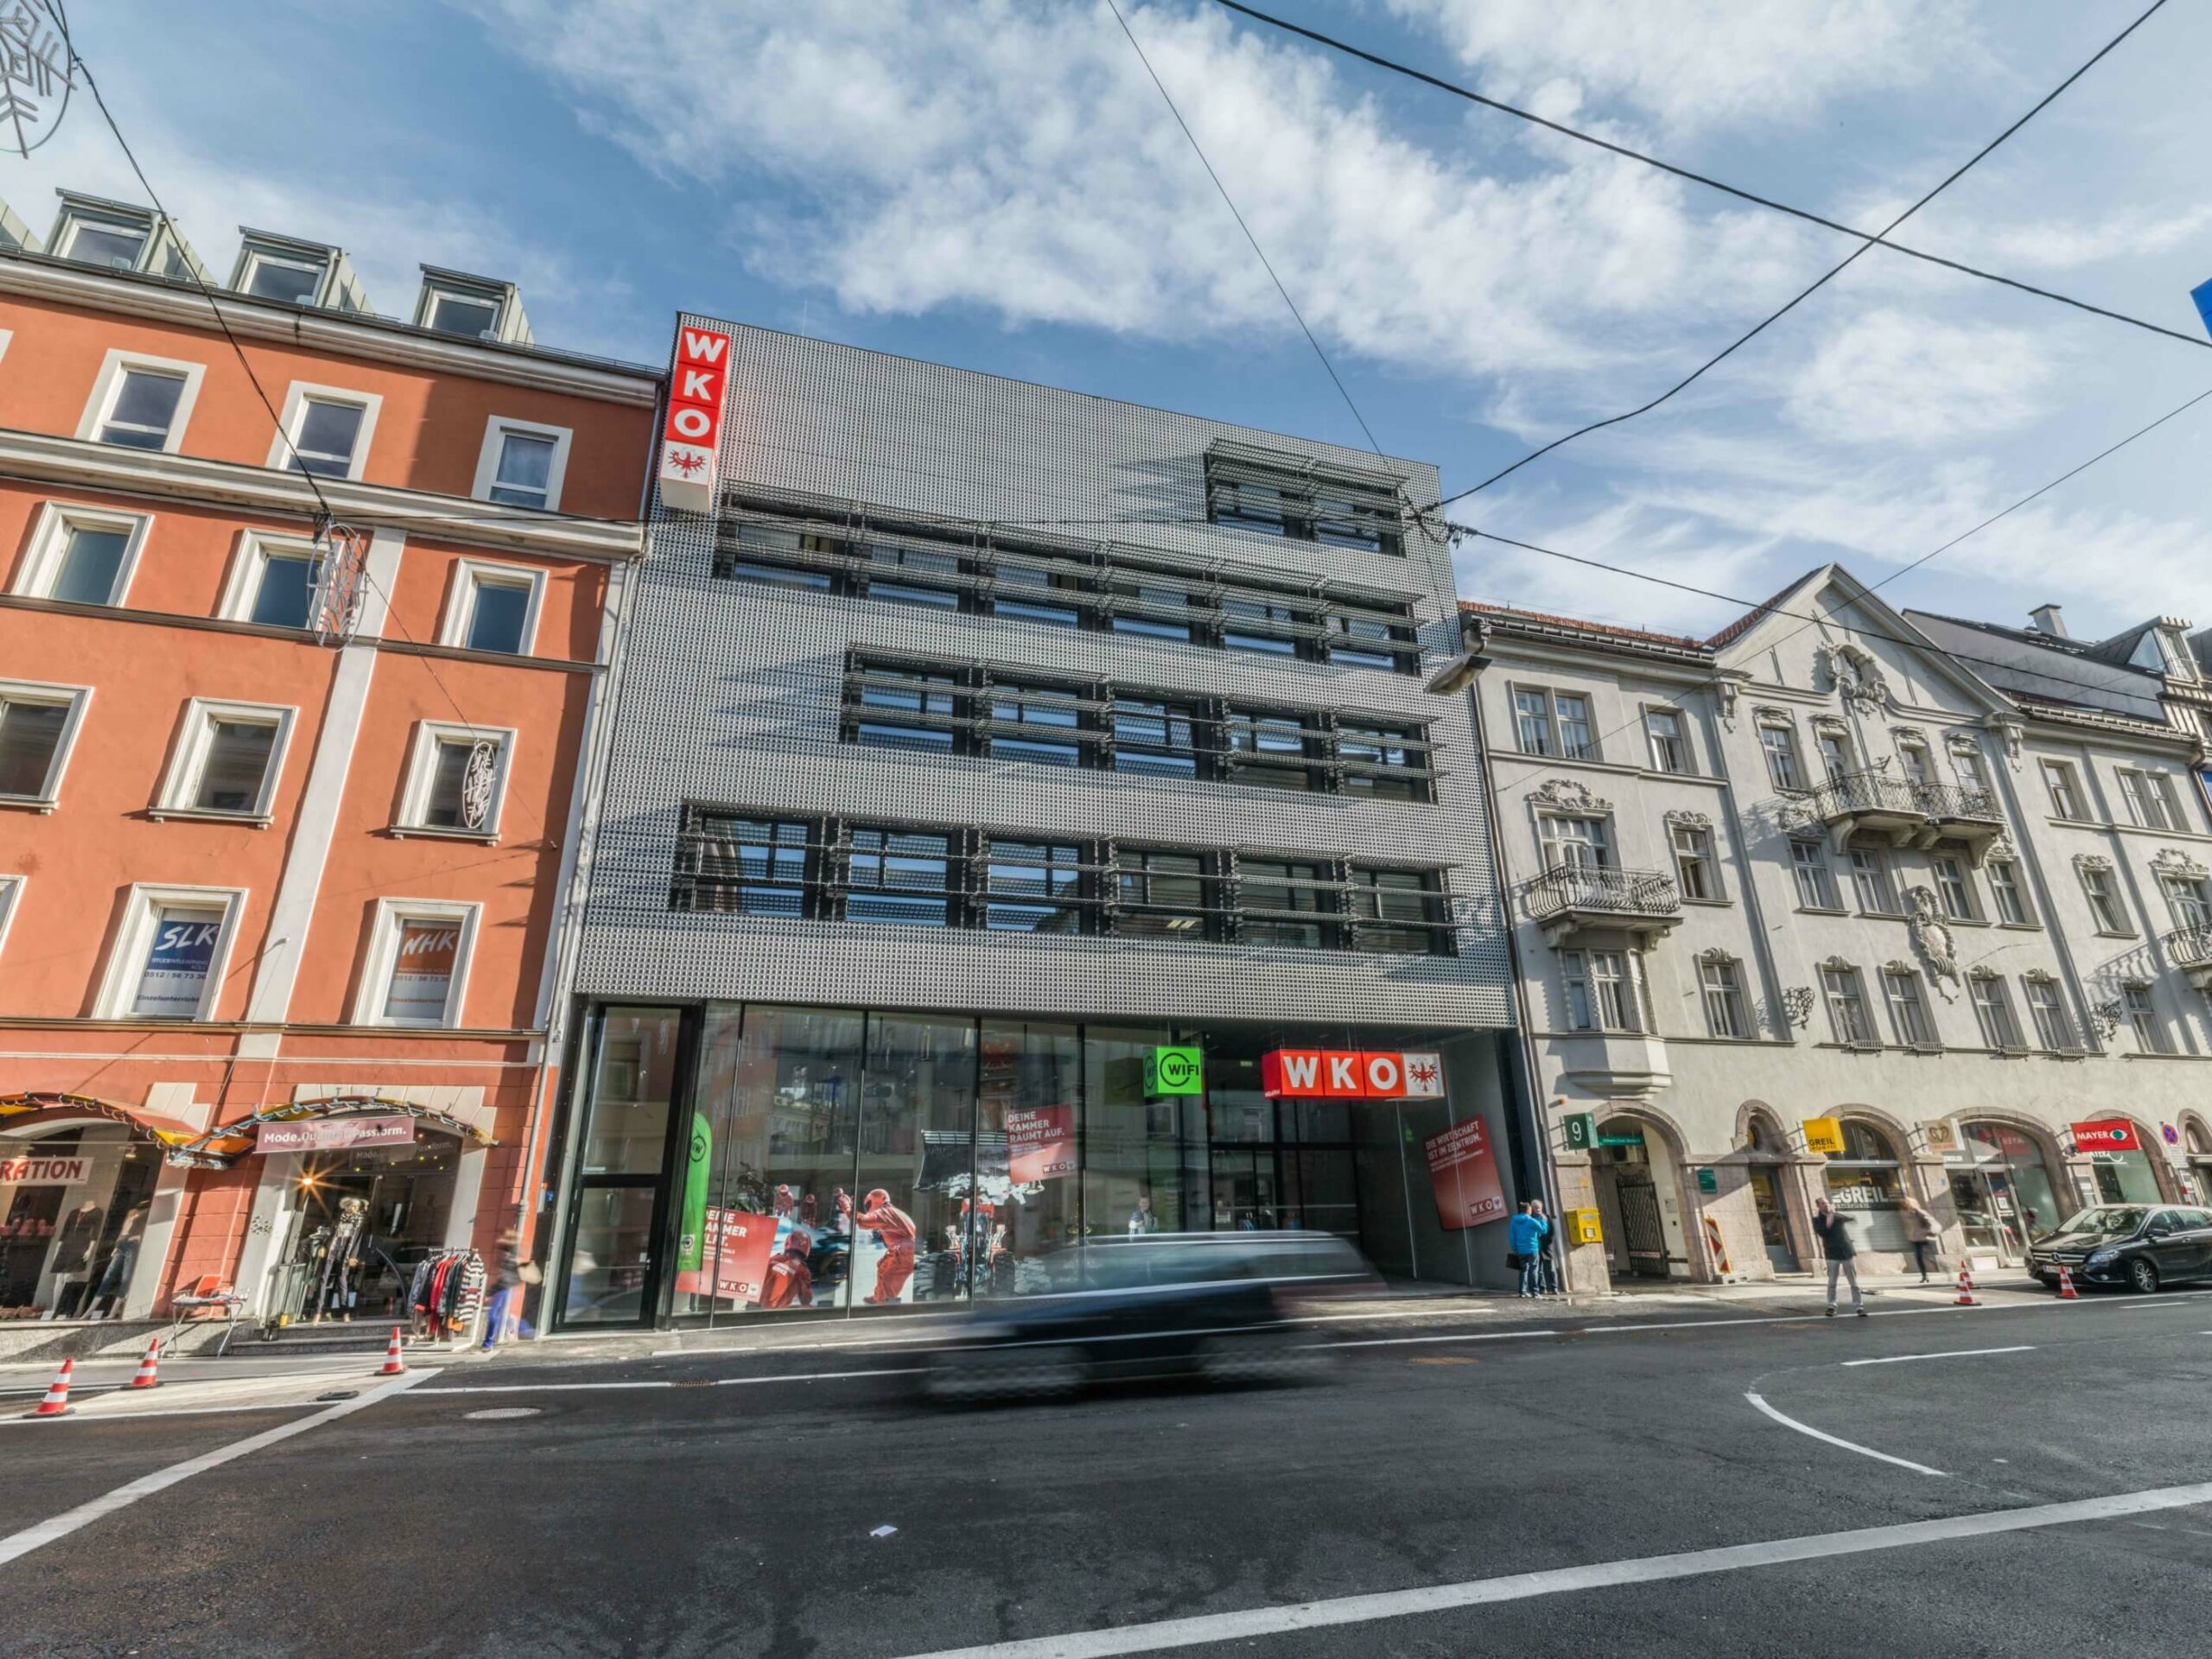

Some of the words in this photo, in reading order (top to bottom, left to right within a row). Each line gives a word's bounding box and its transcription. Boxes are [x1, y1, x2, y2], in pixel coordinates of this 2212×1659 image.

[674, 332, 726, 437] WKO
[155, 925, 219, 950] SLK
[402, 931, 457, 956] NHK
[1167, 1064, 1199, 1076] WIFI
[1283, 1056, 1398, 1090] WKO
[1007, 1111, 1036, 1123] DEINE
[1008, 1119, 1050, 1133] KAMMER
[1045, 1128, 1065, 1138] AUF.
[1572, 1122, 1582, 1141] 9
[1808, 1137, 1834, 1147] GREIL
[2076, 1131, 2109, 1141] MAYER
[0, 1160, 83, 1181] RATION
[1840, 1186, 1889, 1204] GREIL
[1471, 1201, 1493, 1215] WKO
[704, 1221, 747, 1238] AMMER
[719, 1281, 748, 1294] WKO
